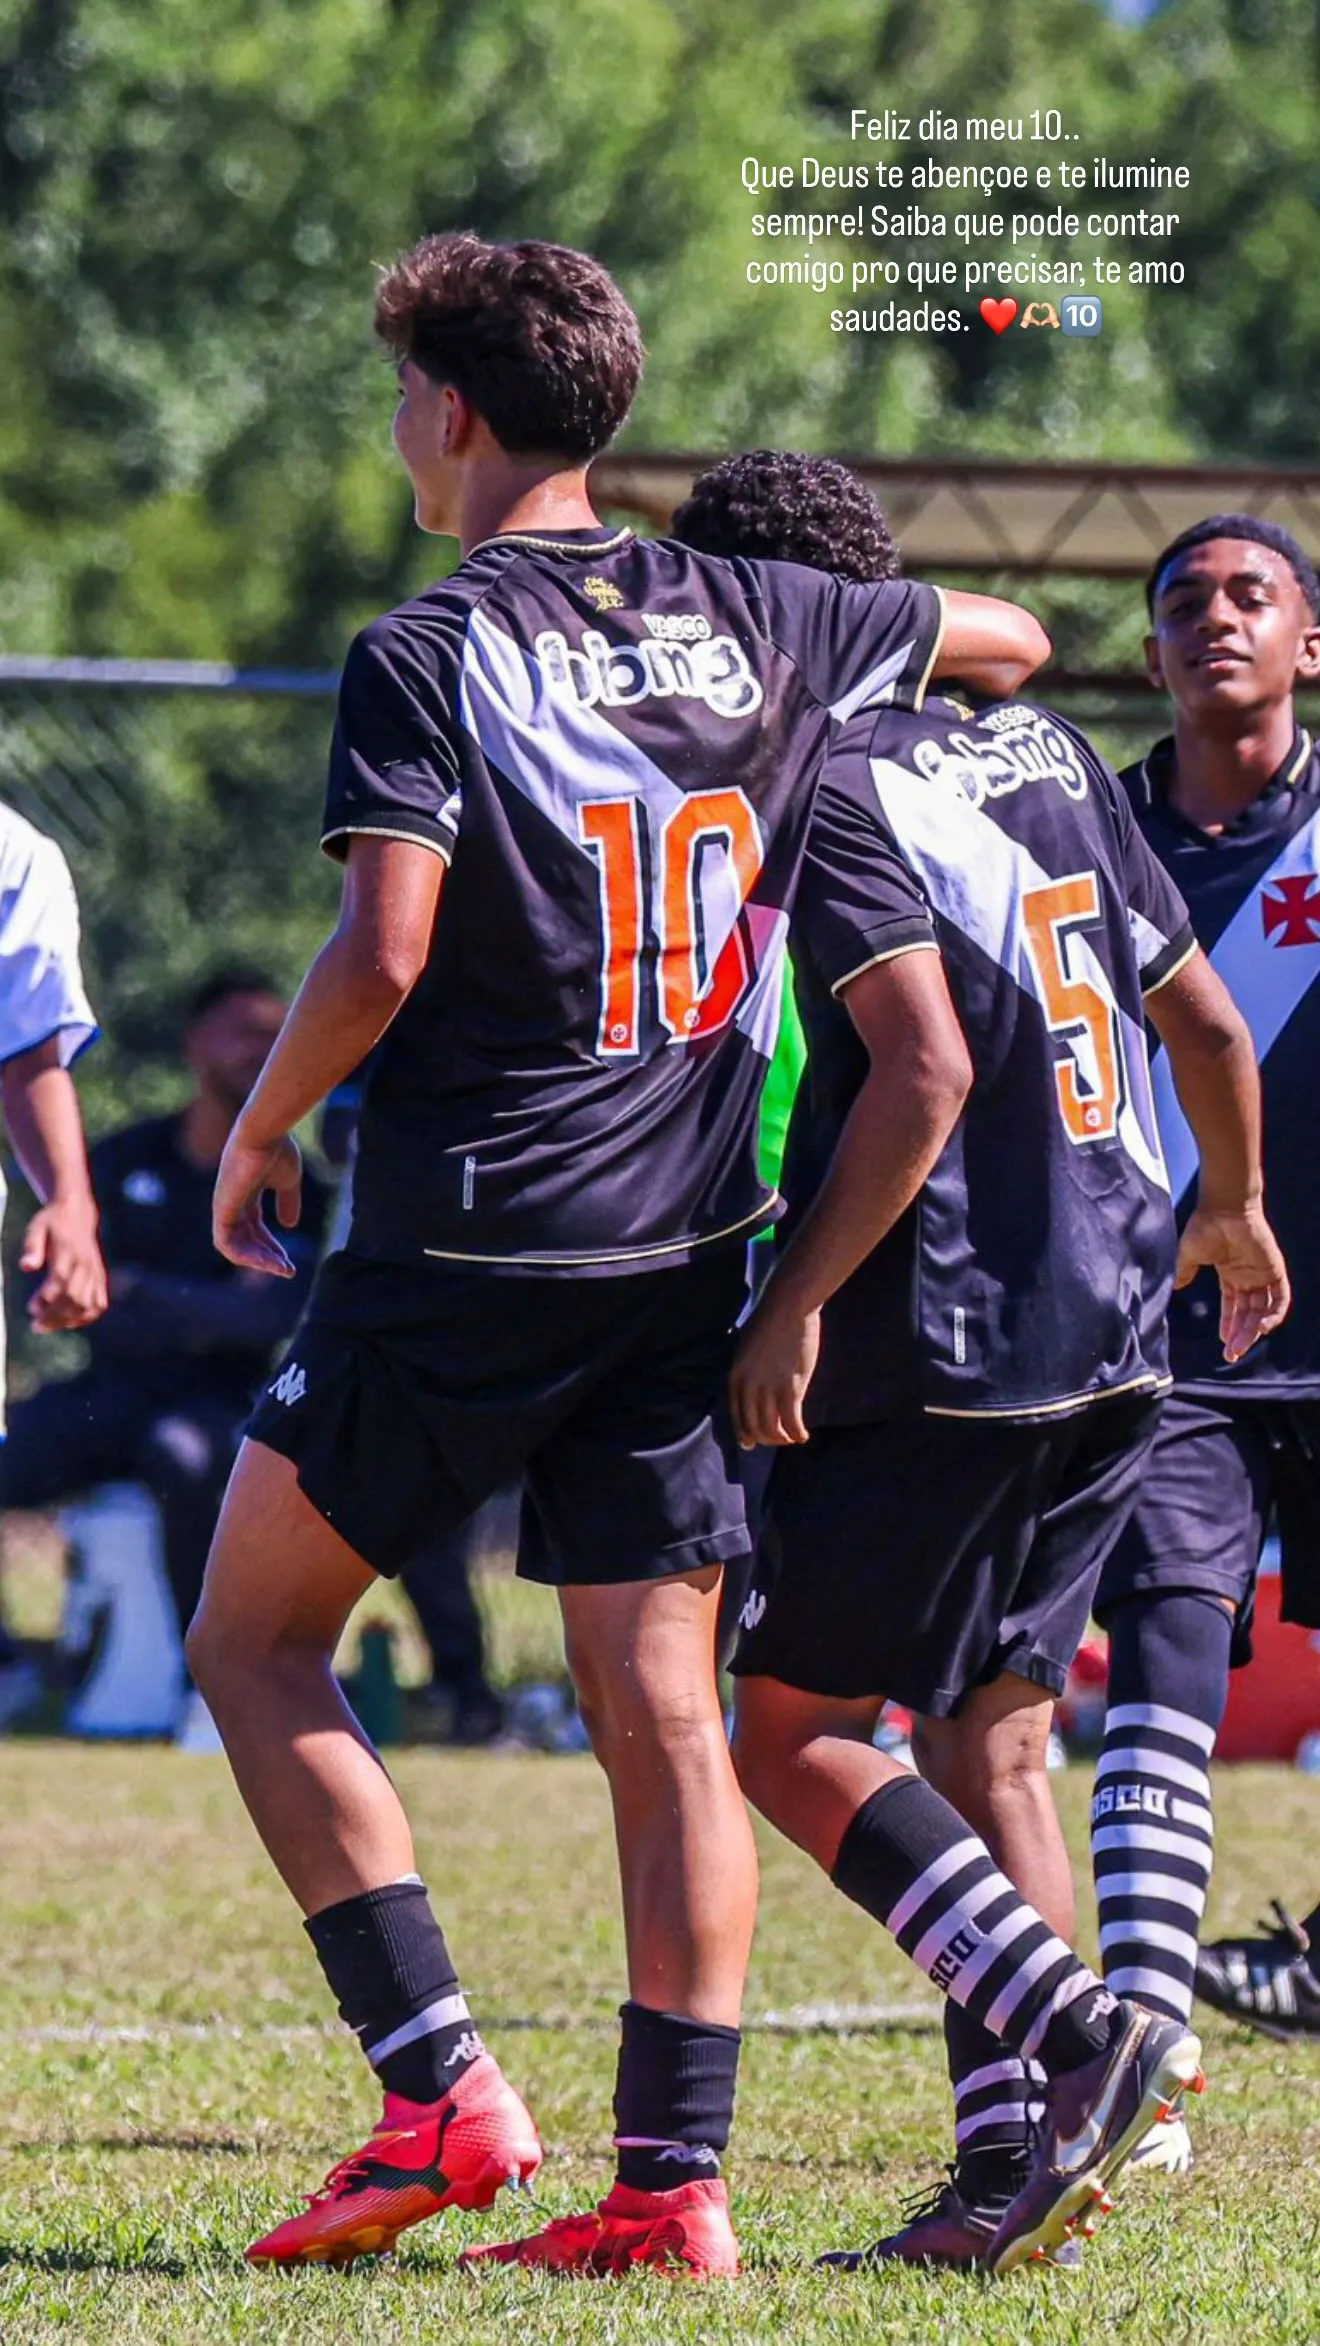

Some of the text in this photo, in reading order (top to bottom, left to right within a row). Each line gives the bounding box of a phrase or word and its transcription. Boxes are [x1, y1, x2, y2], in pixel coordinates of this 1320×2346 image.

[641, 613, 712, 641] VASCO
[576, 785, 764, 1055] 10
[1020, 869, 1117, 1146] 5
[1093, 1784, 1169, 1819] SCO
